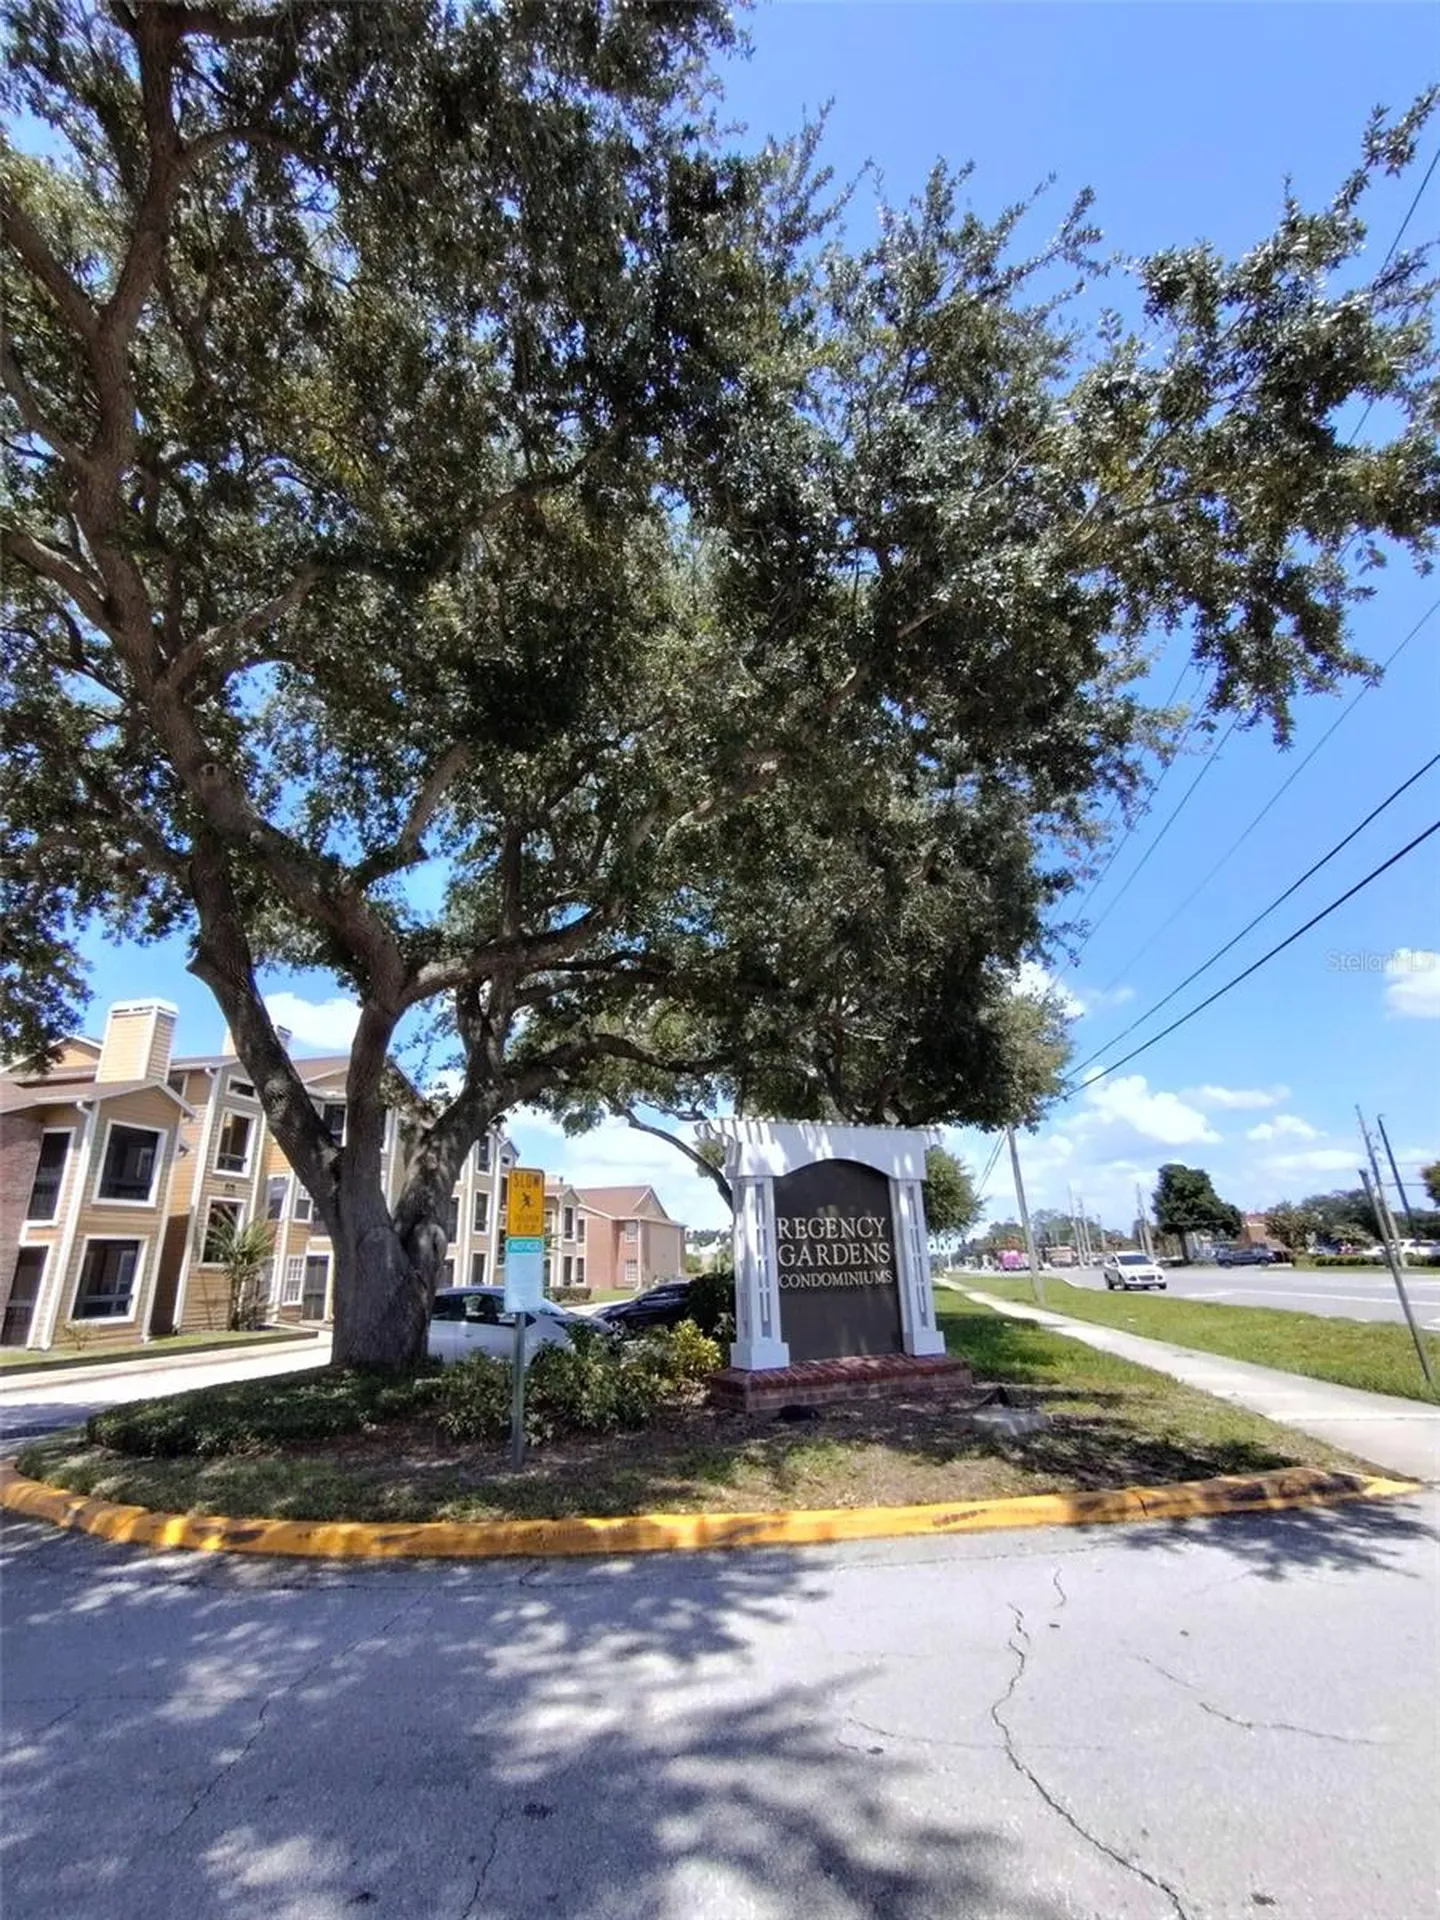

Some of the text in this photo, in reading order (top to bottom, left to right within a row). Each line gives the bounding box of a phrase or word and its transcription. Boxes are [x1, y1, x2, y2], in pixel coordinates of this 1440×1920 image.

[777, 1217, 885, 1239] REGENCY
[778, 1243, 890, 1266] GARDENS
[779, 1270, 892, 1288] CONDOMINIUMS
